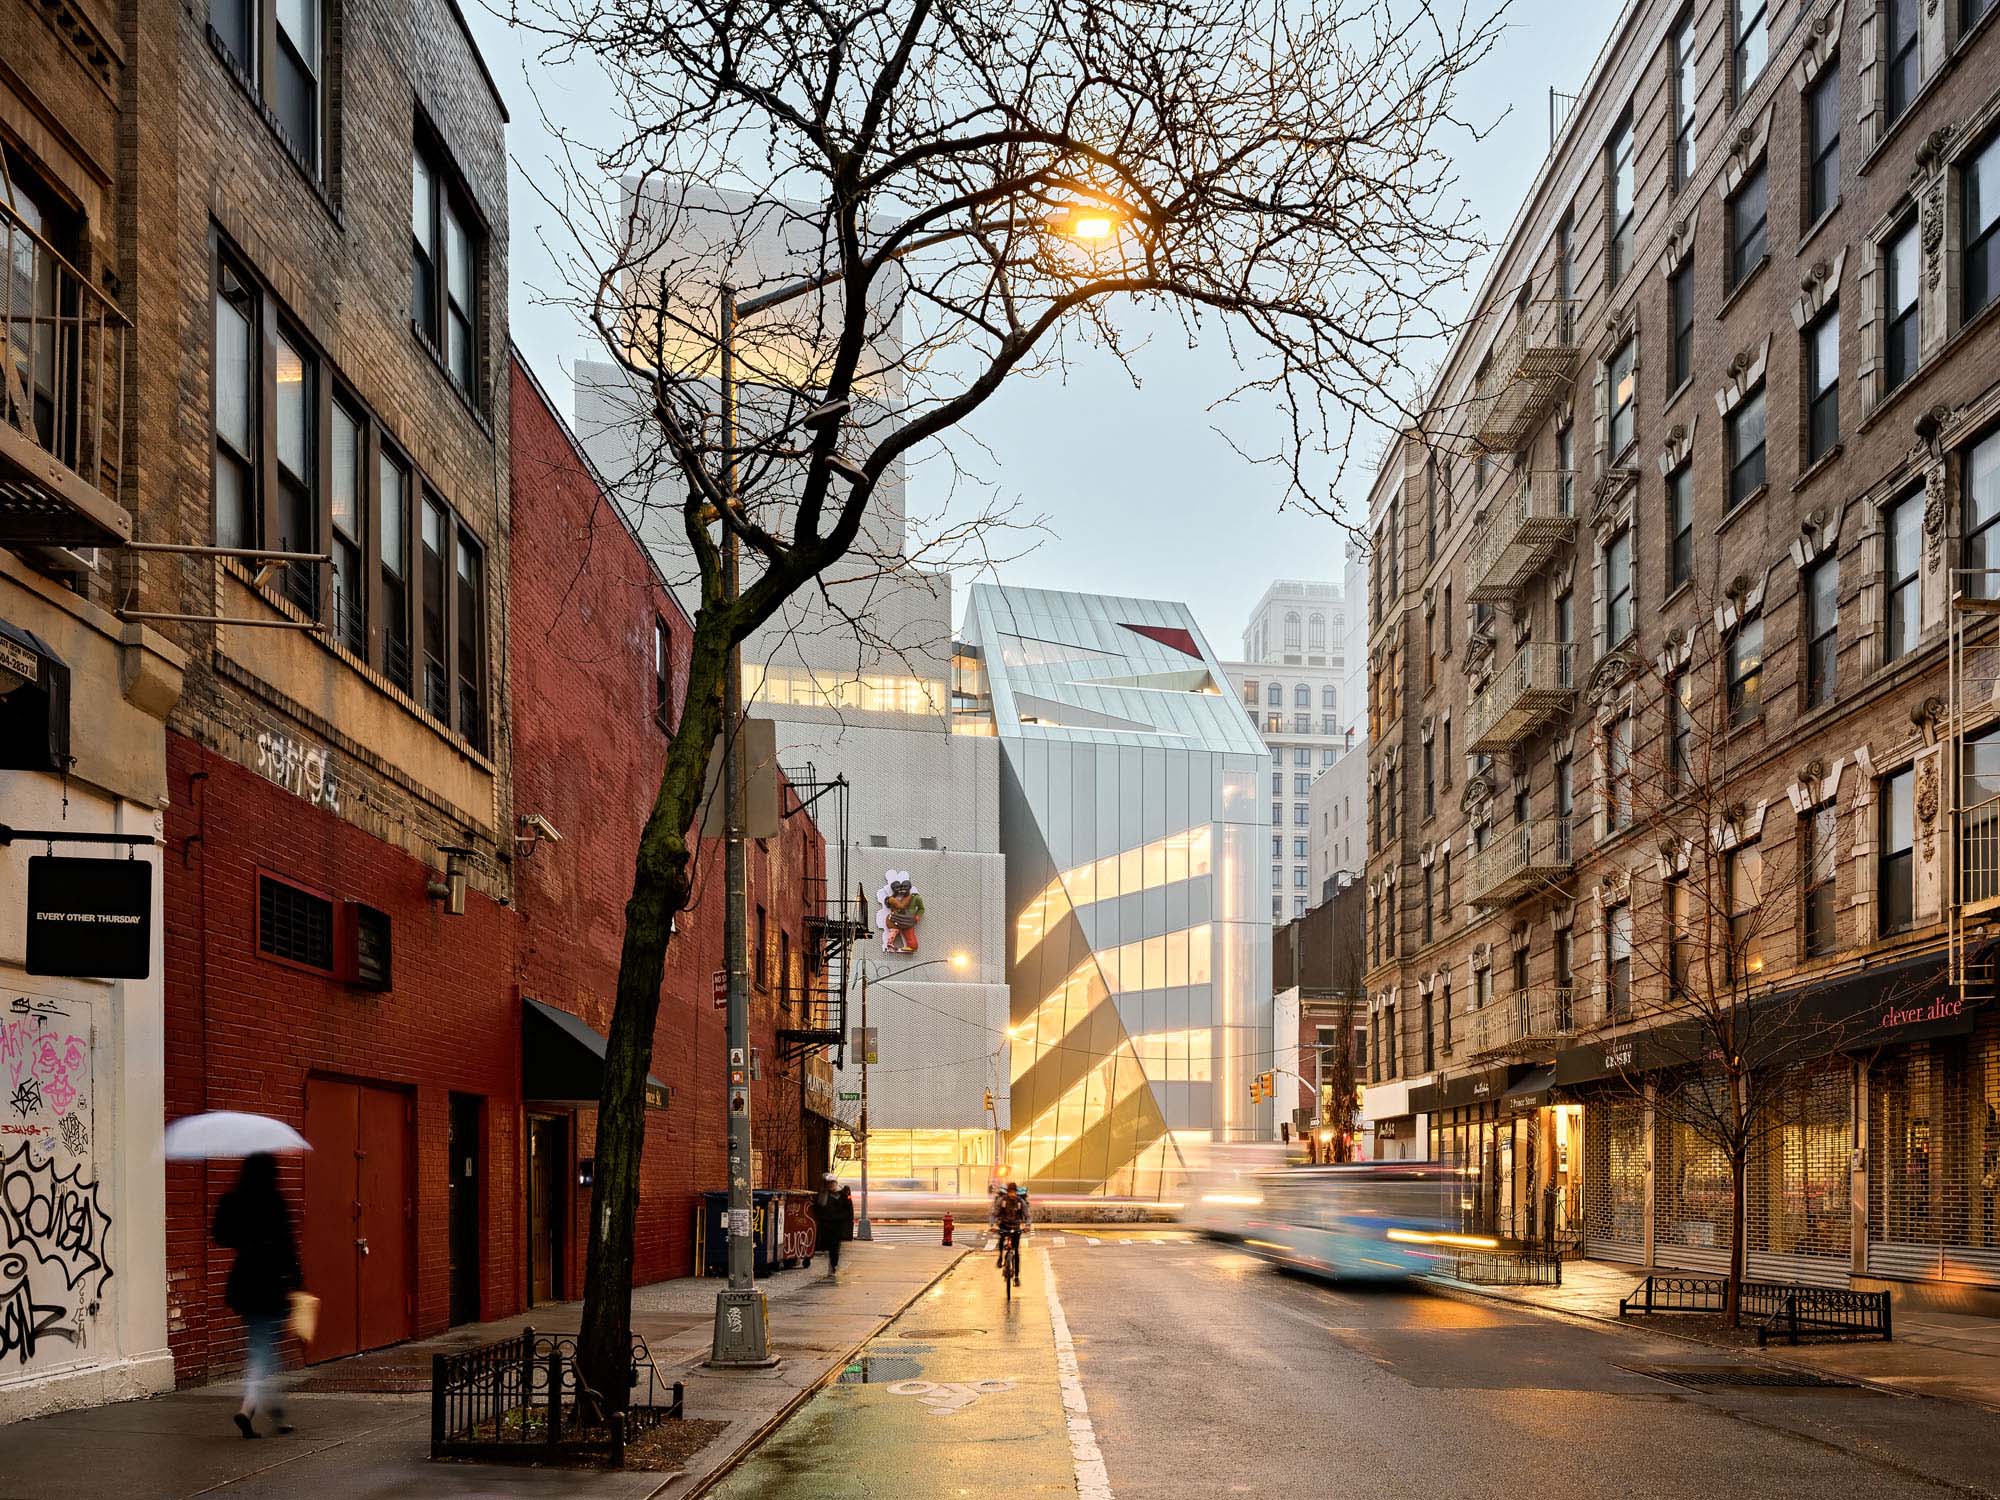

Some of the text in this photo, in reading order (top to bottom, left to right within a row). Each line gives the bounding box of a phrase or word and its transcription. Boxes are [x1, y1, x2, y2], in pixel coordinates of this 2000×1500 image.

[9, 642, 21, 655] IRON
[22, 650, 36, 660] WORK
[0, 652, 28, 675] 04-2837
[36, 912, 141, 924] EVERY OTHER THURSDAY
[1882, 995, 1961, 1027] clever alice
[1513, 1098, 1525, 1108] Prince
[1526, 1096, 1537, 1106] Street
